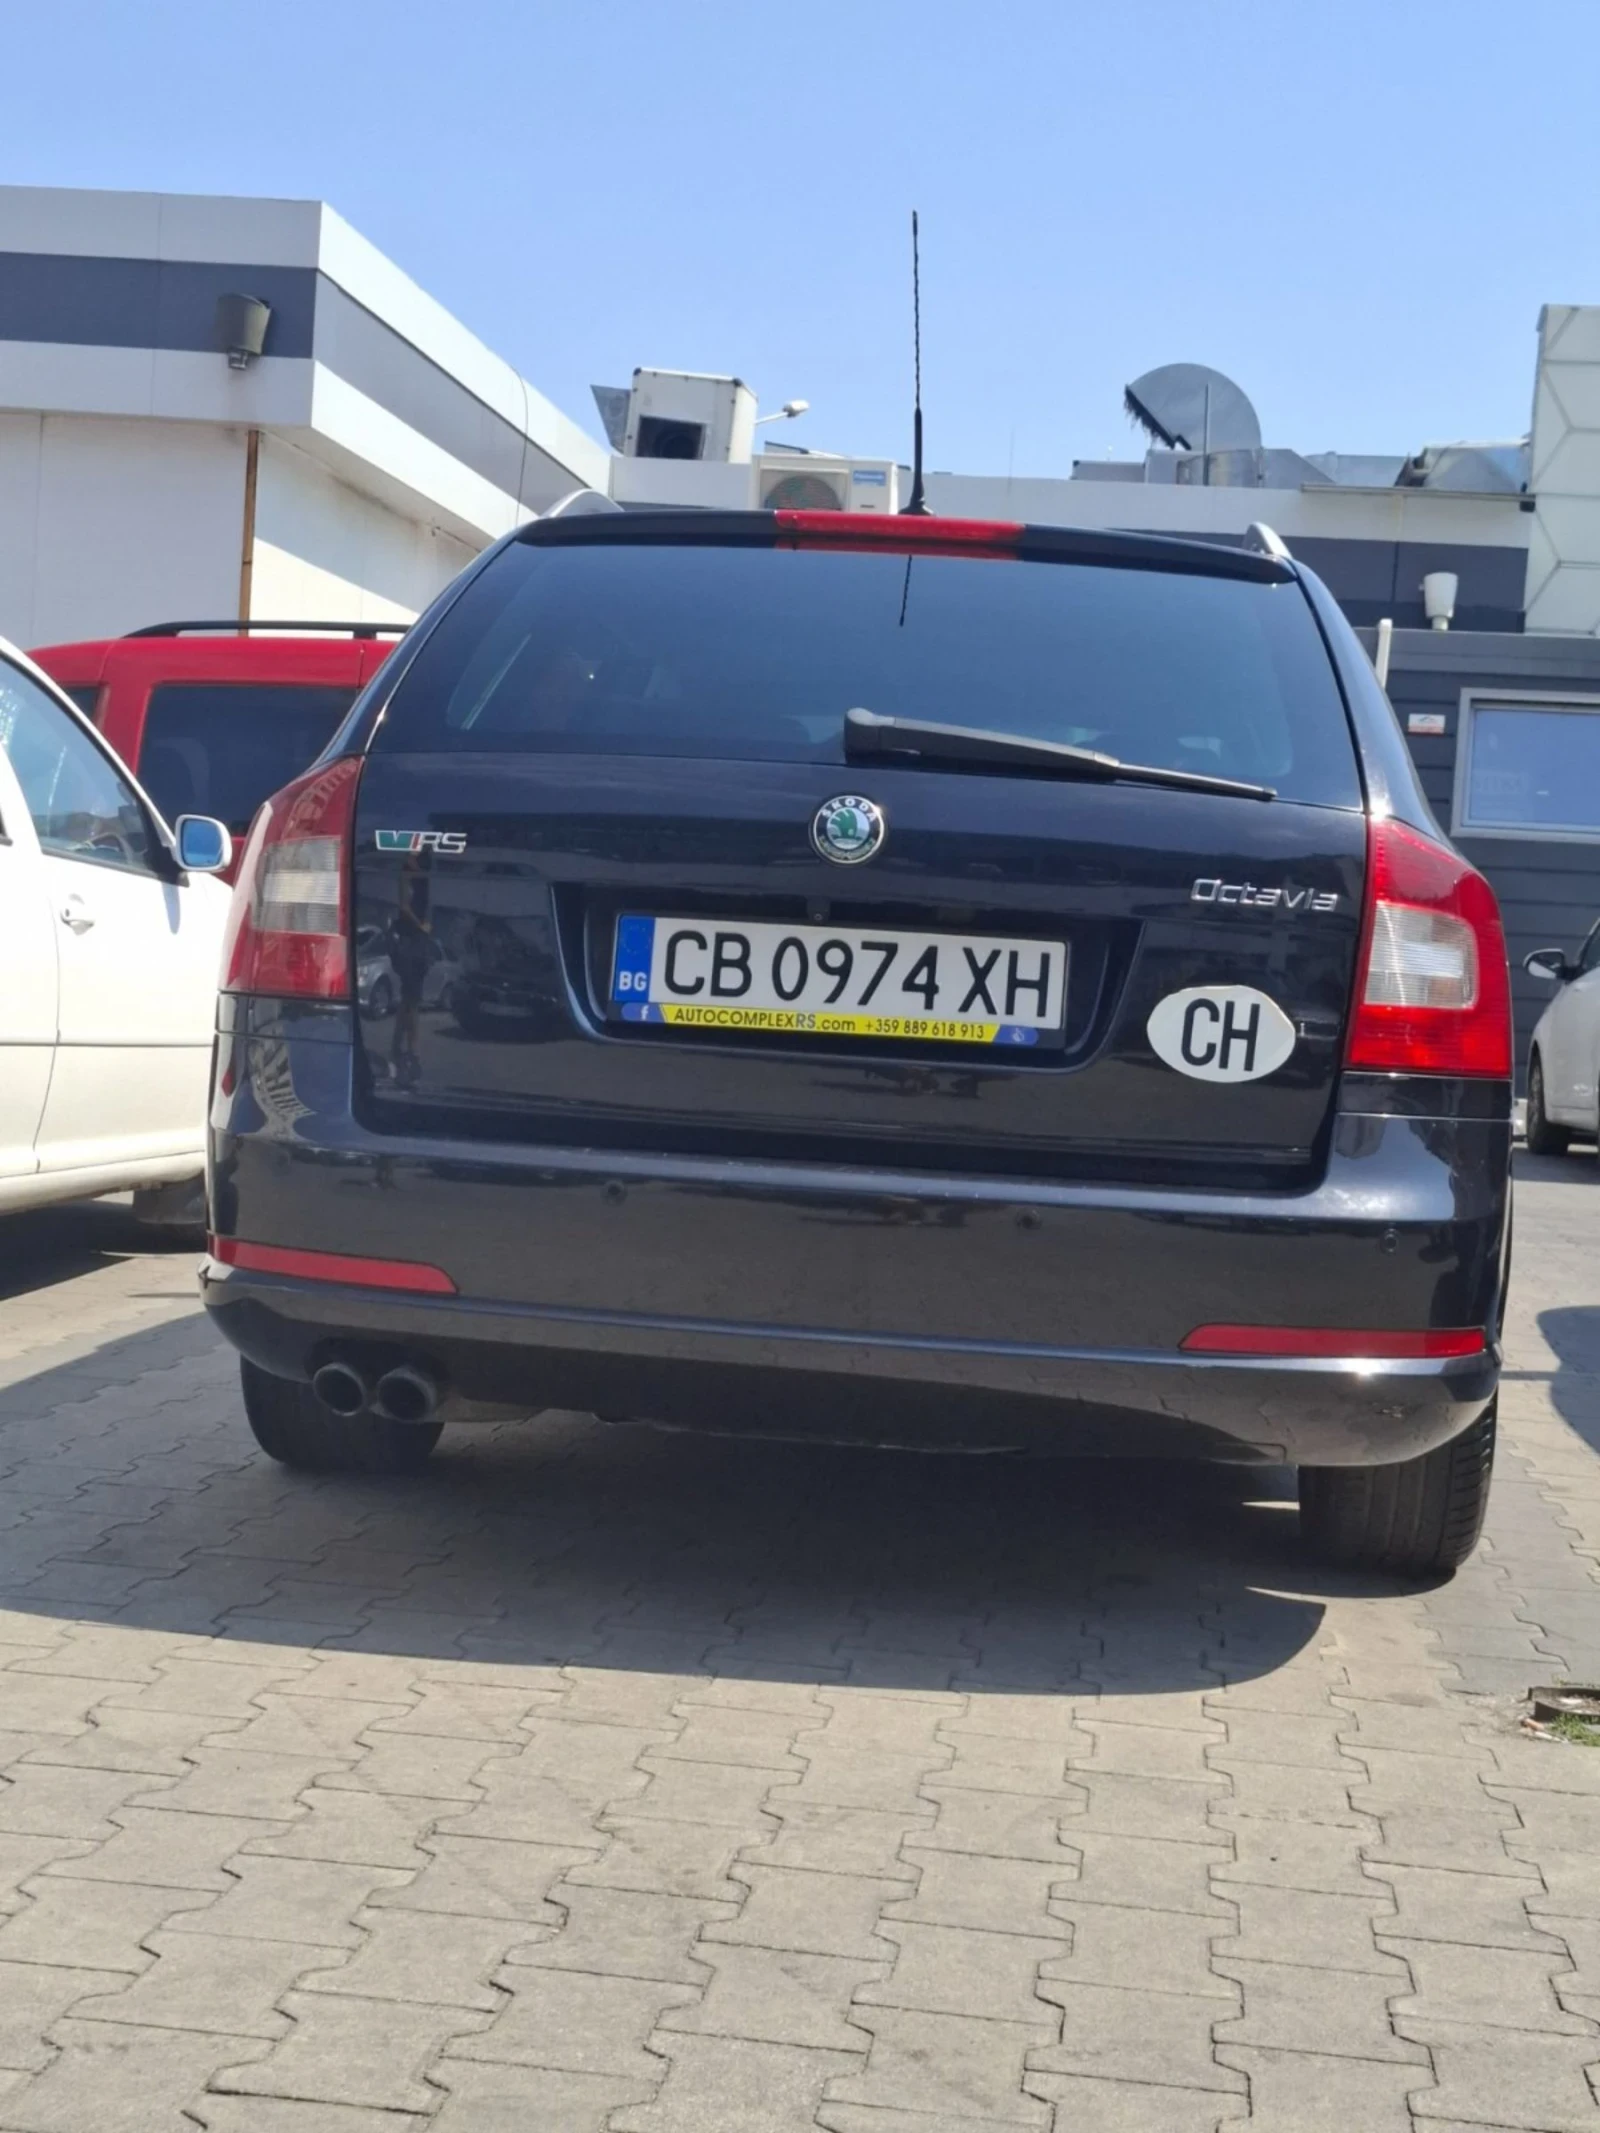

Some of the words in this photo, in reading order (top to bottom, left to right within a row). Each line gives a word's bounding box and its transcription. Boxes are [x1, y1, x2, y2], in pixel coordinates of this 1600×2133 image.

[1191, 878, 1339, 912] Octavia
[618, 970, 647, 992] BG
[663, 929, 753, 998] CB
[771, 936, 940, 1012] 0974
[957, 946, 1051, 1018] XH
[673, 1007, 857, 1033] AUTOCOMPLEXRS.com
[864, 1018, 900, 1034] +359
[903, 1019, 928, 1036] 889
[931, 1021, 957, 1038] 618
[960, 1022, 985, 1040] 913
[1180, 997, 1261, 1073] CH
